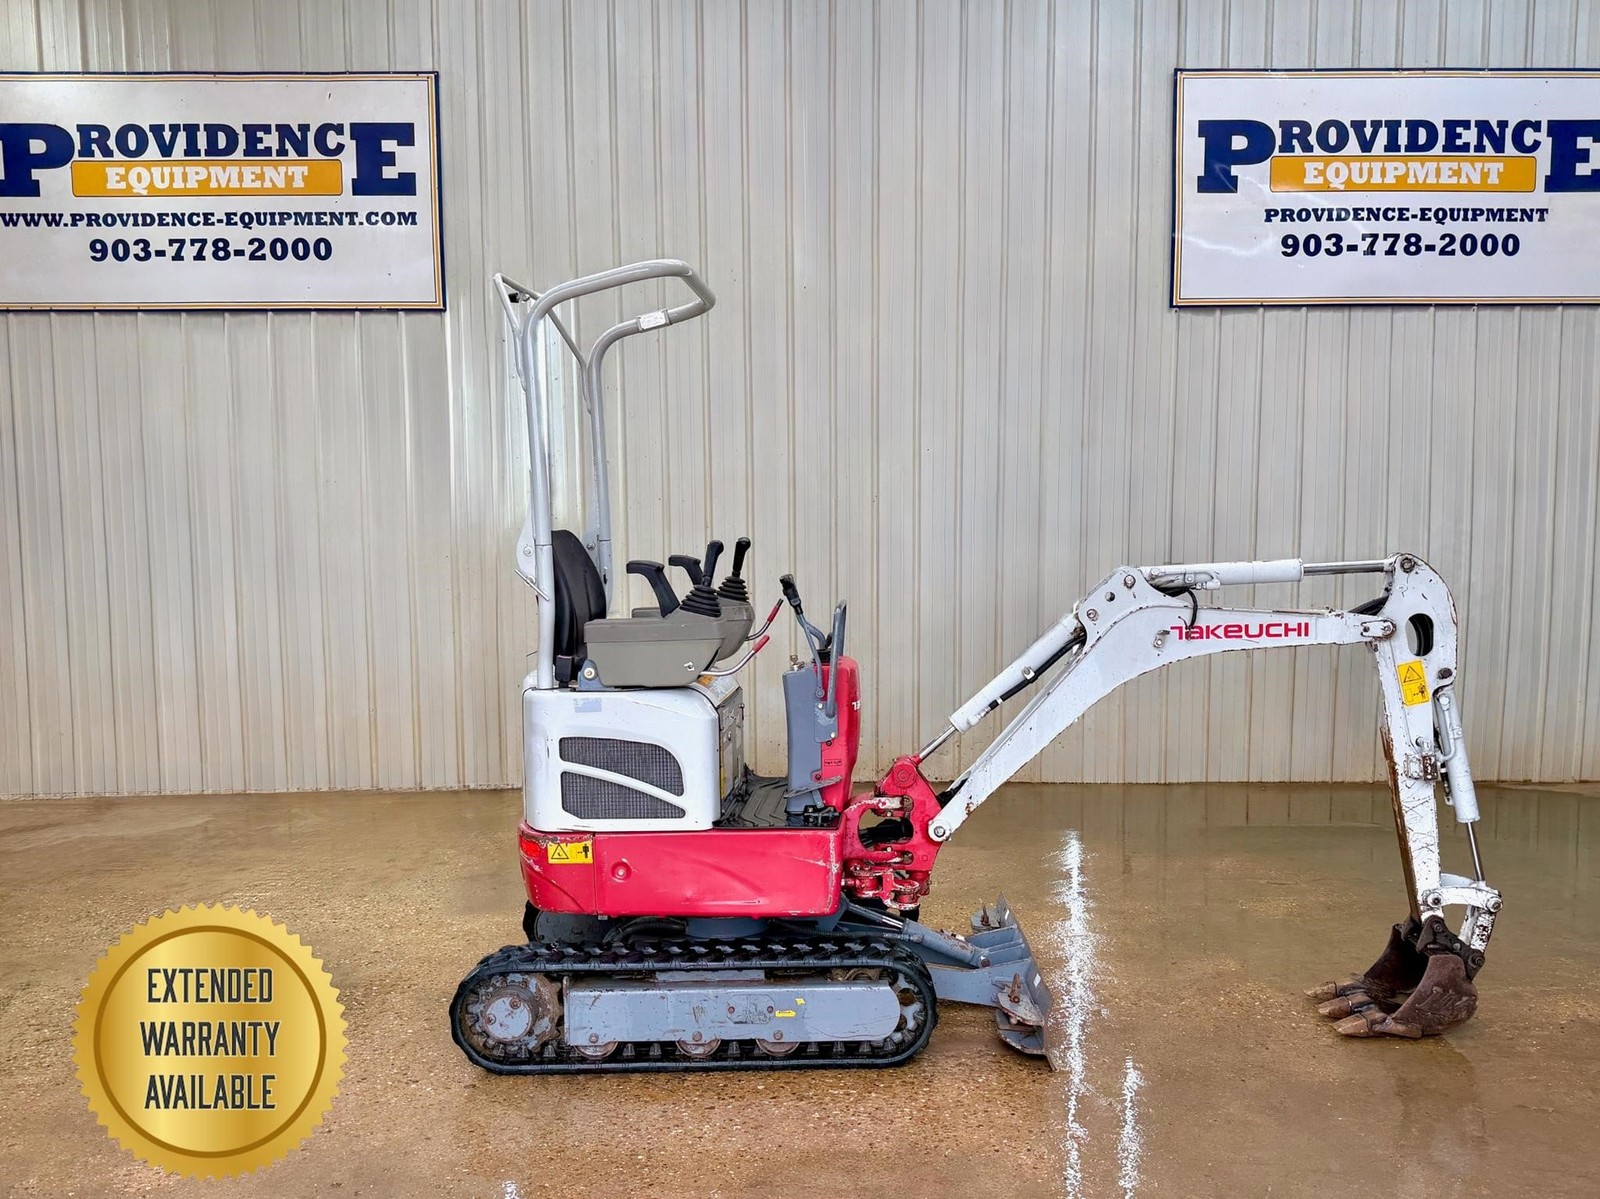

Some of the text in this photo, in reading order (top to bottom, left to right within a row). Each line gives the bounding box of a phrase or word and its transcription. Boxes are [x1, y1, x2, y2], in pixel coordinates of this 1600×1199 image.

[0, 123, 416, 197] PROVIDENCE
[1197, 119, 1600, 193] PROVIDENCE
[106, 166, 308, 195] EQUIPMENT
[1303, 161, 1504, 191] EQUIPMENT
[0, 211, 417, 230] WWW.PROVIDENCE-EQUIPMENT.COM
[1264, 207, 1549, 225] PROVIDENCE-EQUIPMENT
[89, 237, 332, 261] 903-778-2000
[1280, 233, 1520, 257] 903-778-2000
